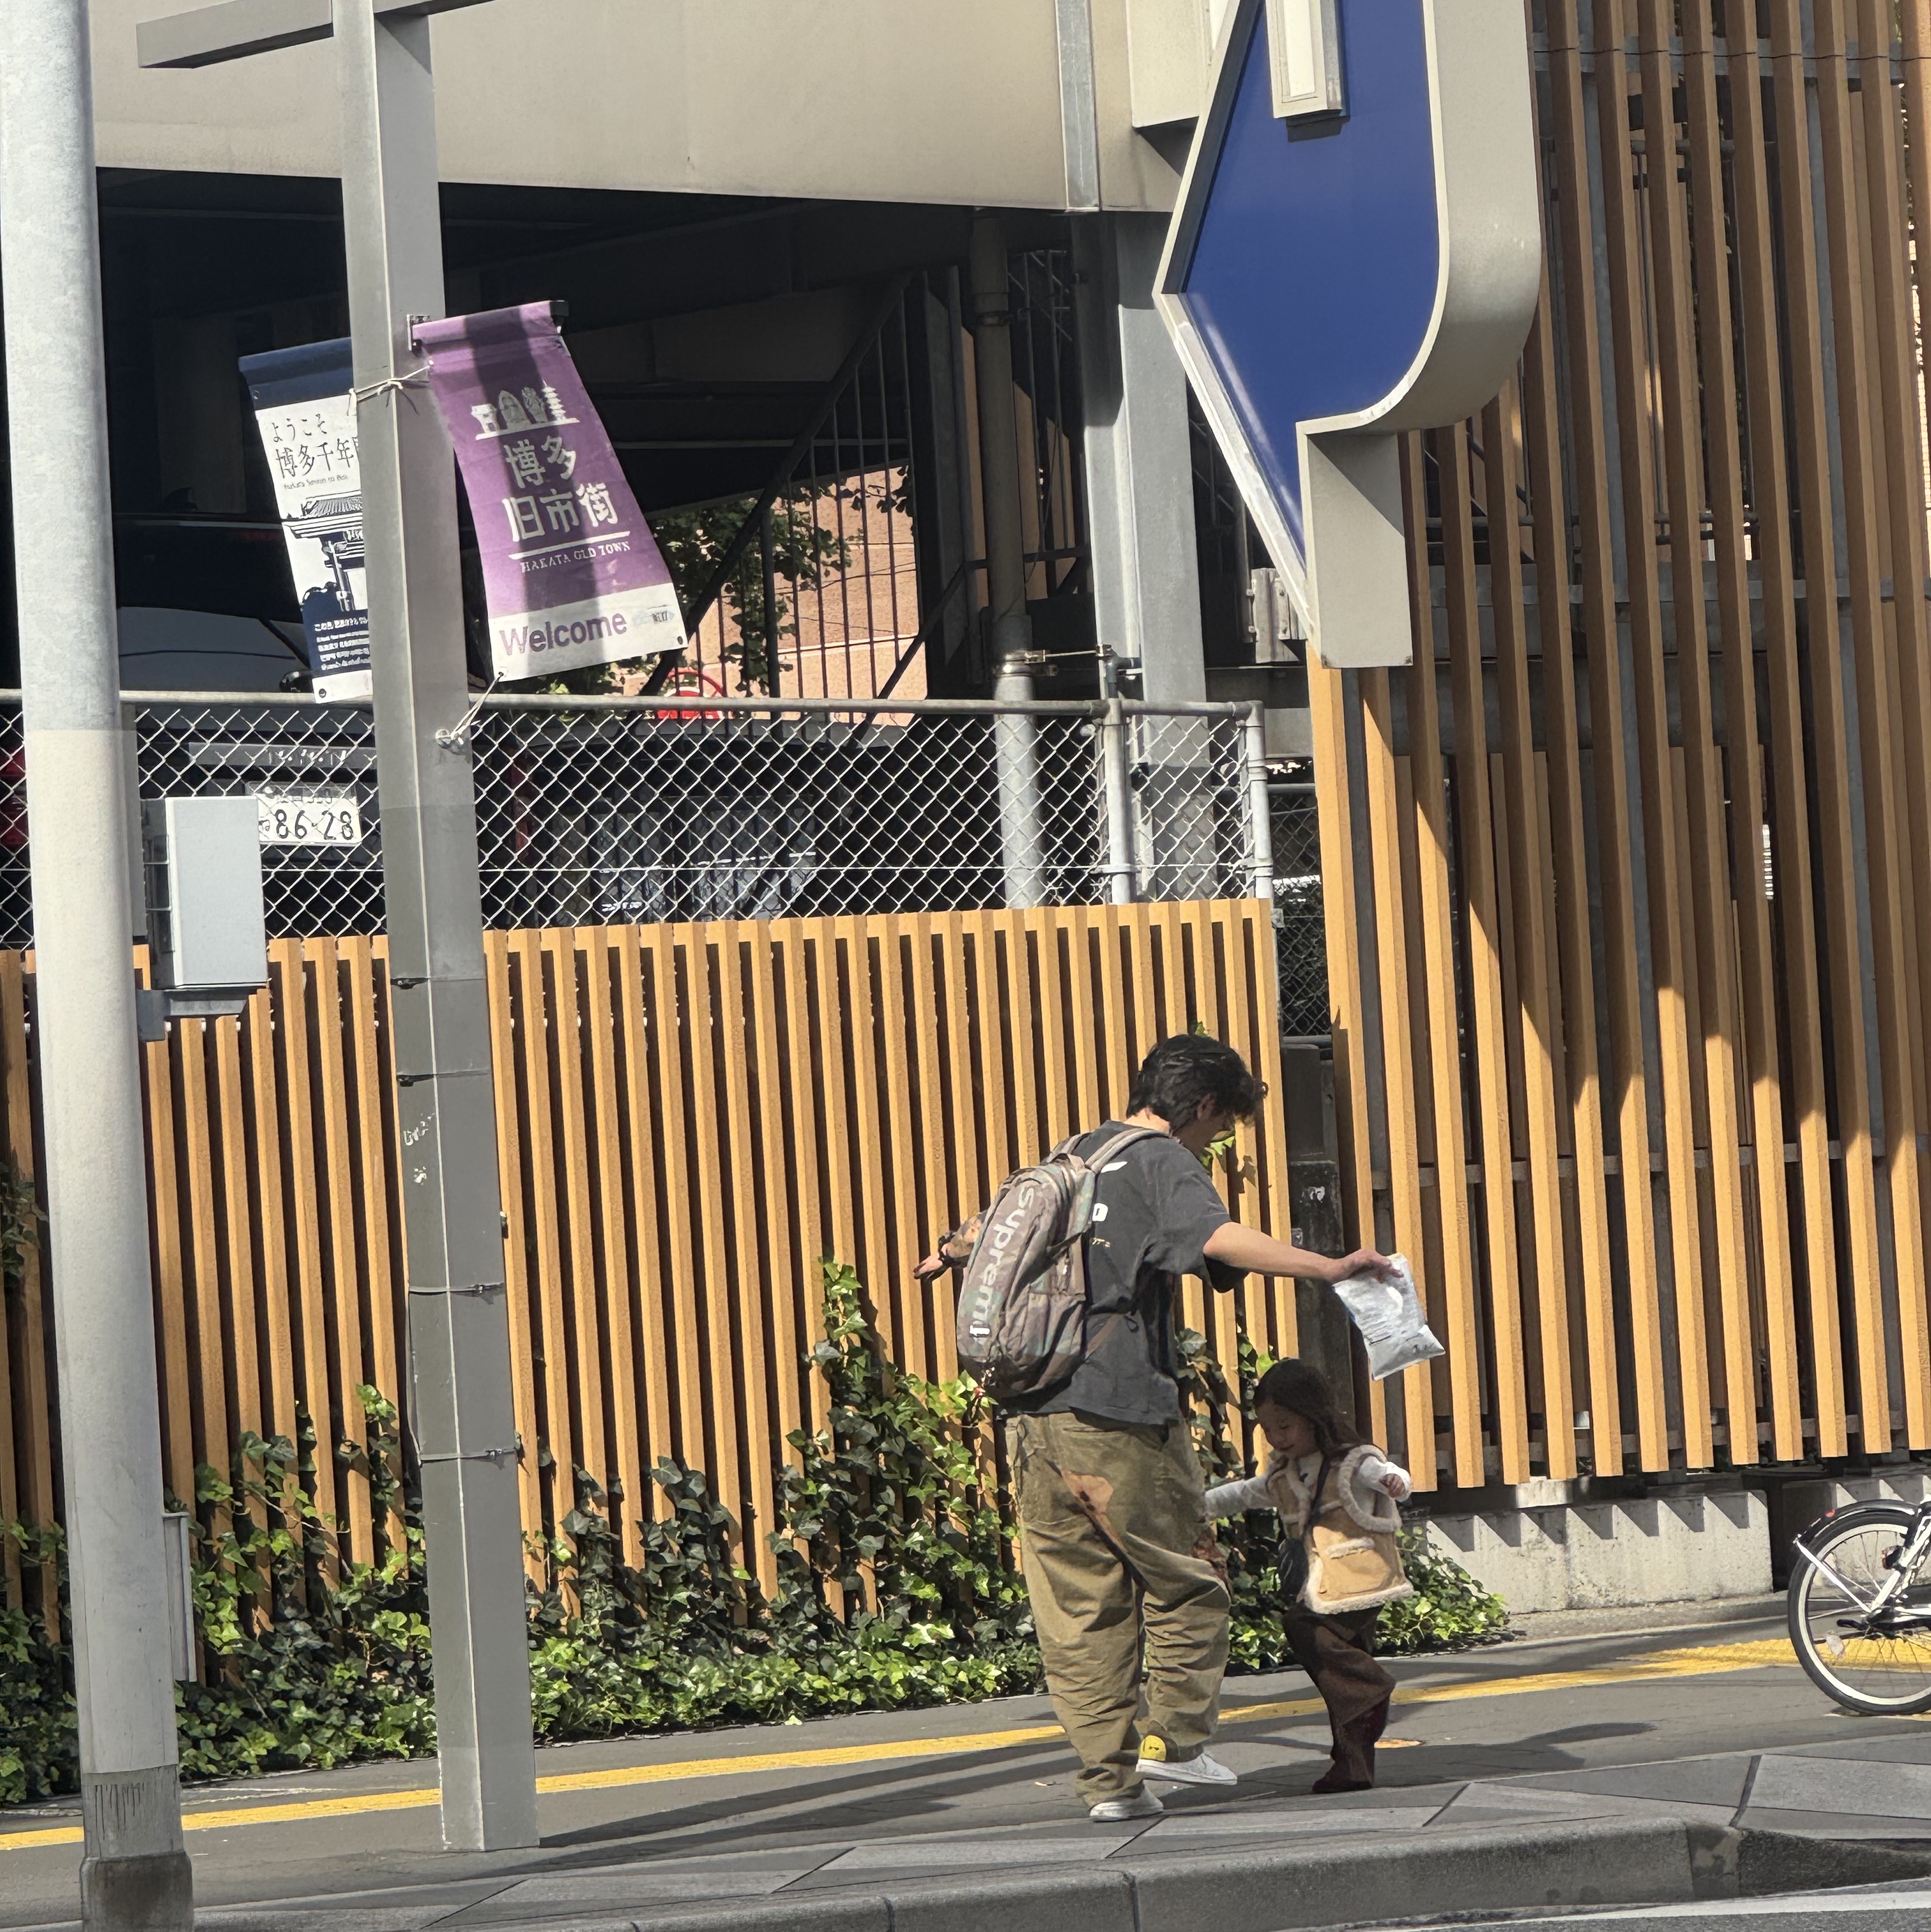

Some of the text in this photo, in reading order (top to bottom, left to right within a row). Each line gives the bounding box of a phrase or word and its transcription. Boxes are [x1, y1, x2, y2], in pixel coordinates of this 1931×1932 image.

[271, 413, 327, 442] ようこそ
[503, 434, 577, 489] 博多
[502, 482, 618, 542] 旧市街
[598, 541, 631, 556] TOWN
[499, 613, 627, 656] Welcome
